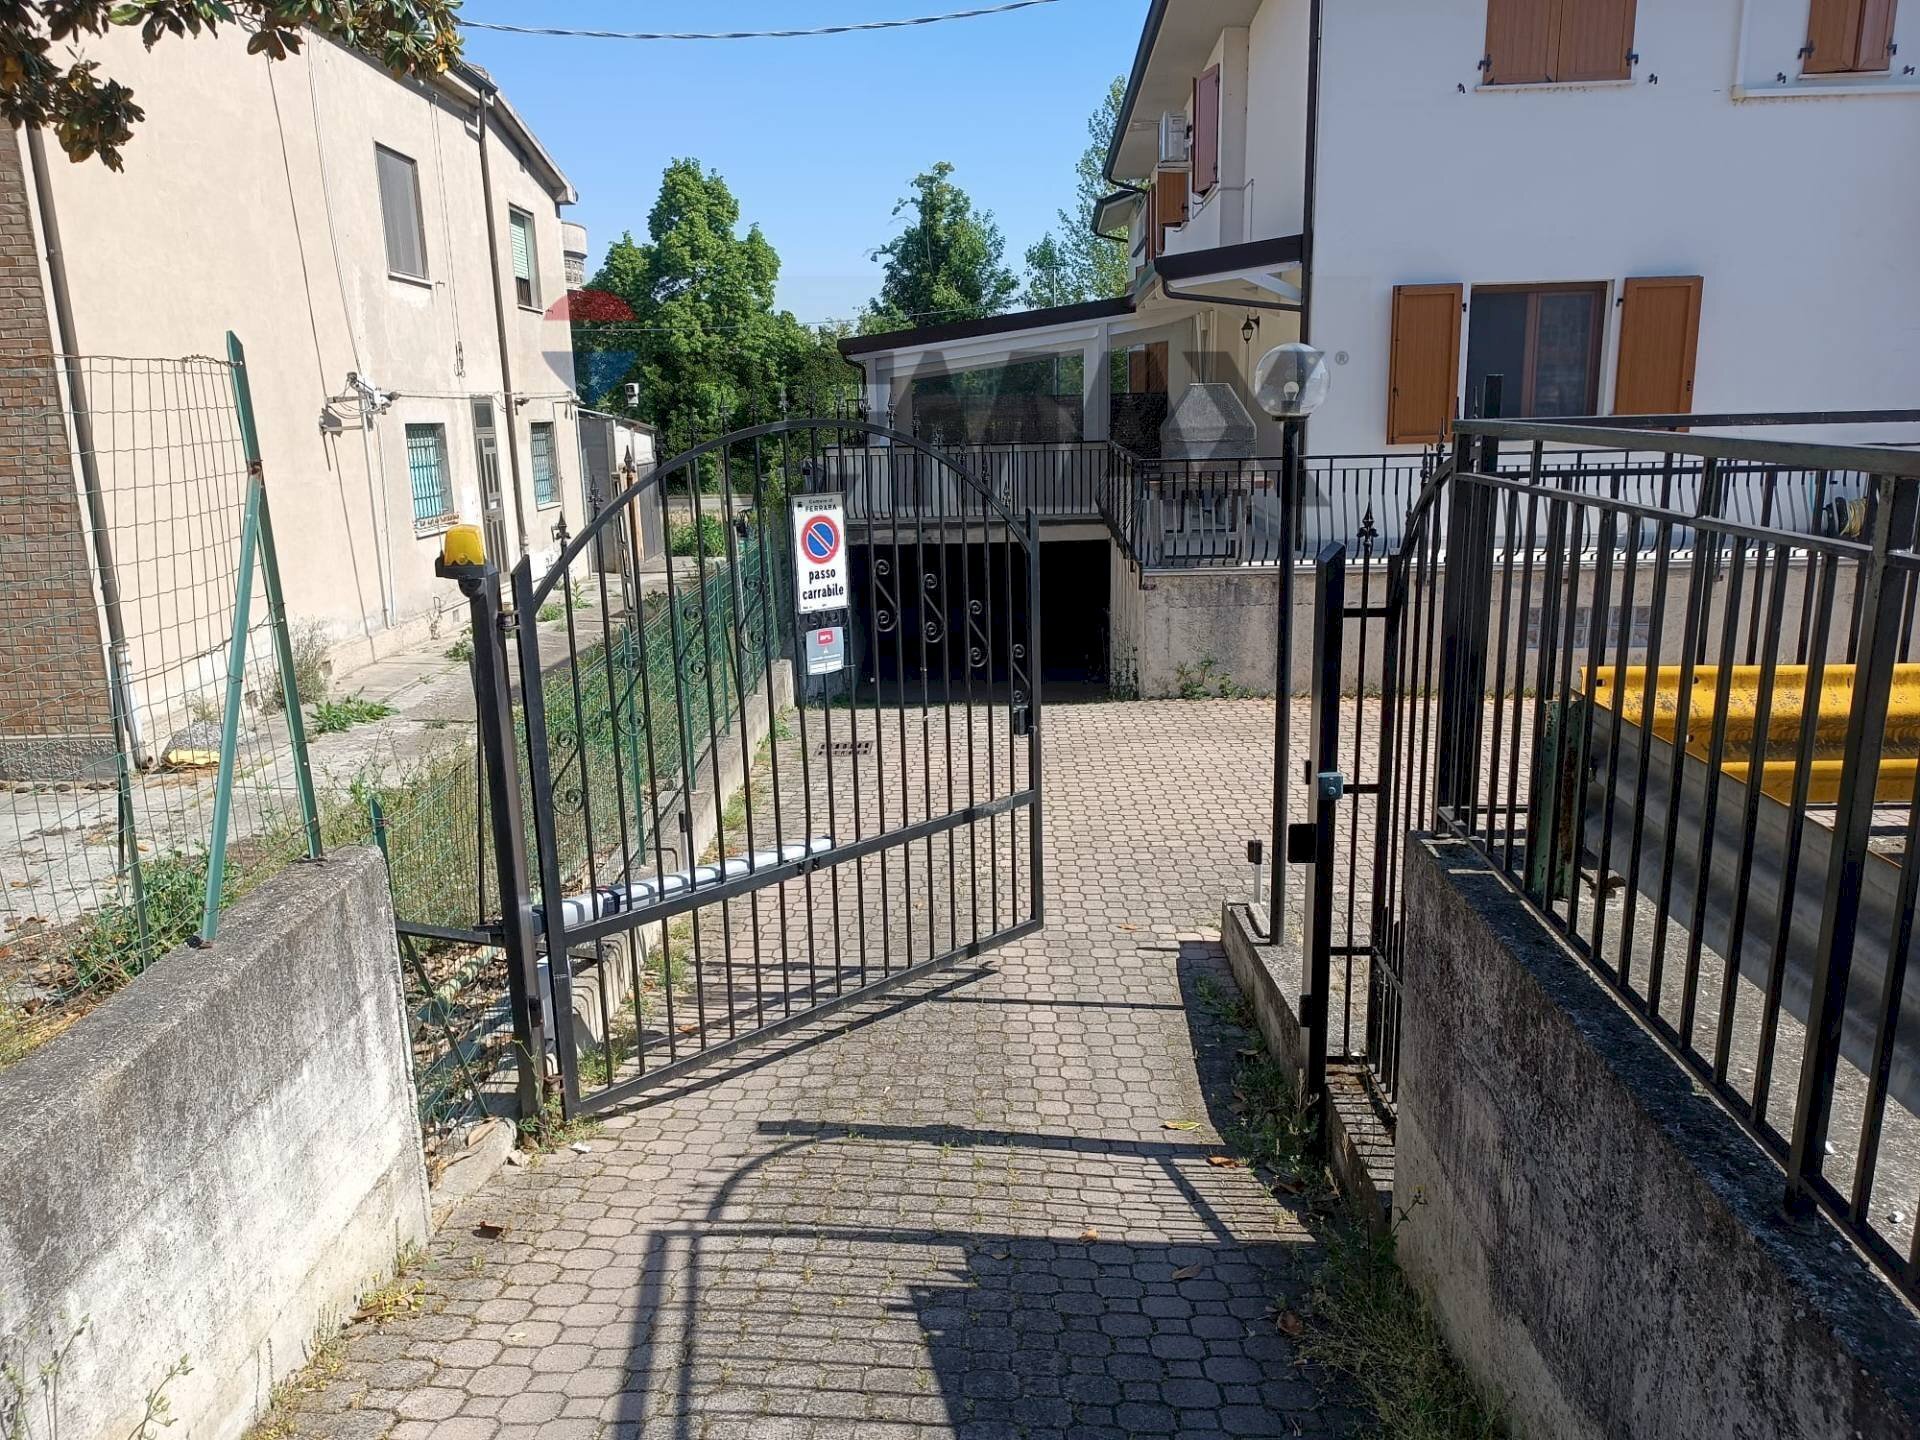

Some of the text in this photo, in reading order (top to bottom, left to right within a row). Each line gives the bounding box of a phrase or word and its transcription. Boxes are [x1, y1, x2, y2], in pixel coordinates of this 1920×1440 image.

[805, 503, 837, 512] FERRARA
[809, 568, 836, 584] passo
[802, 583, 844, 600] carrabile
